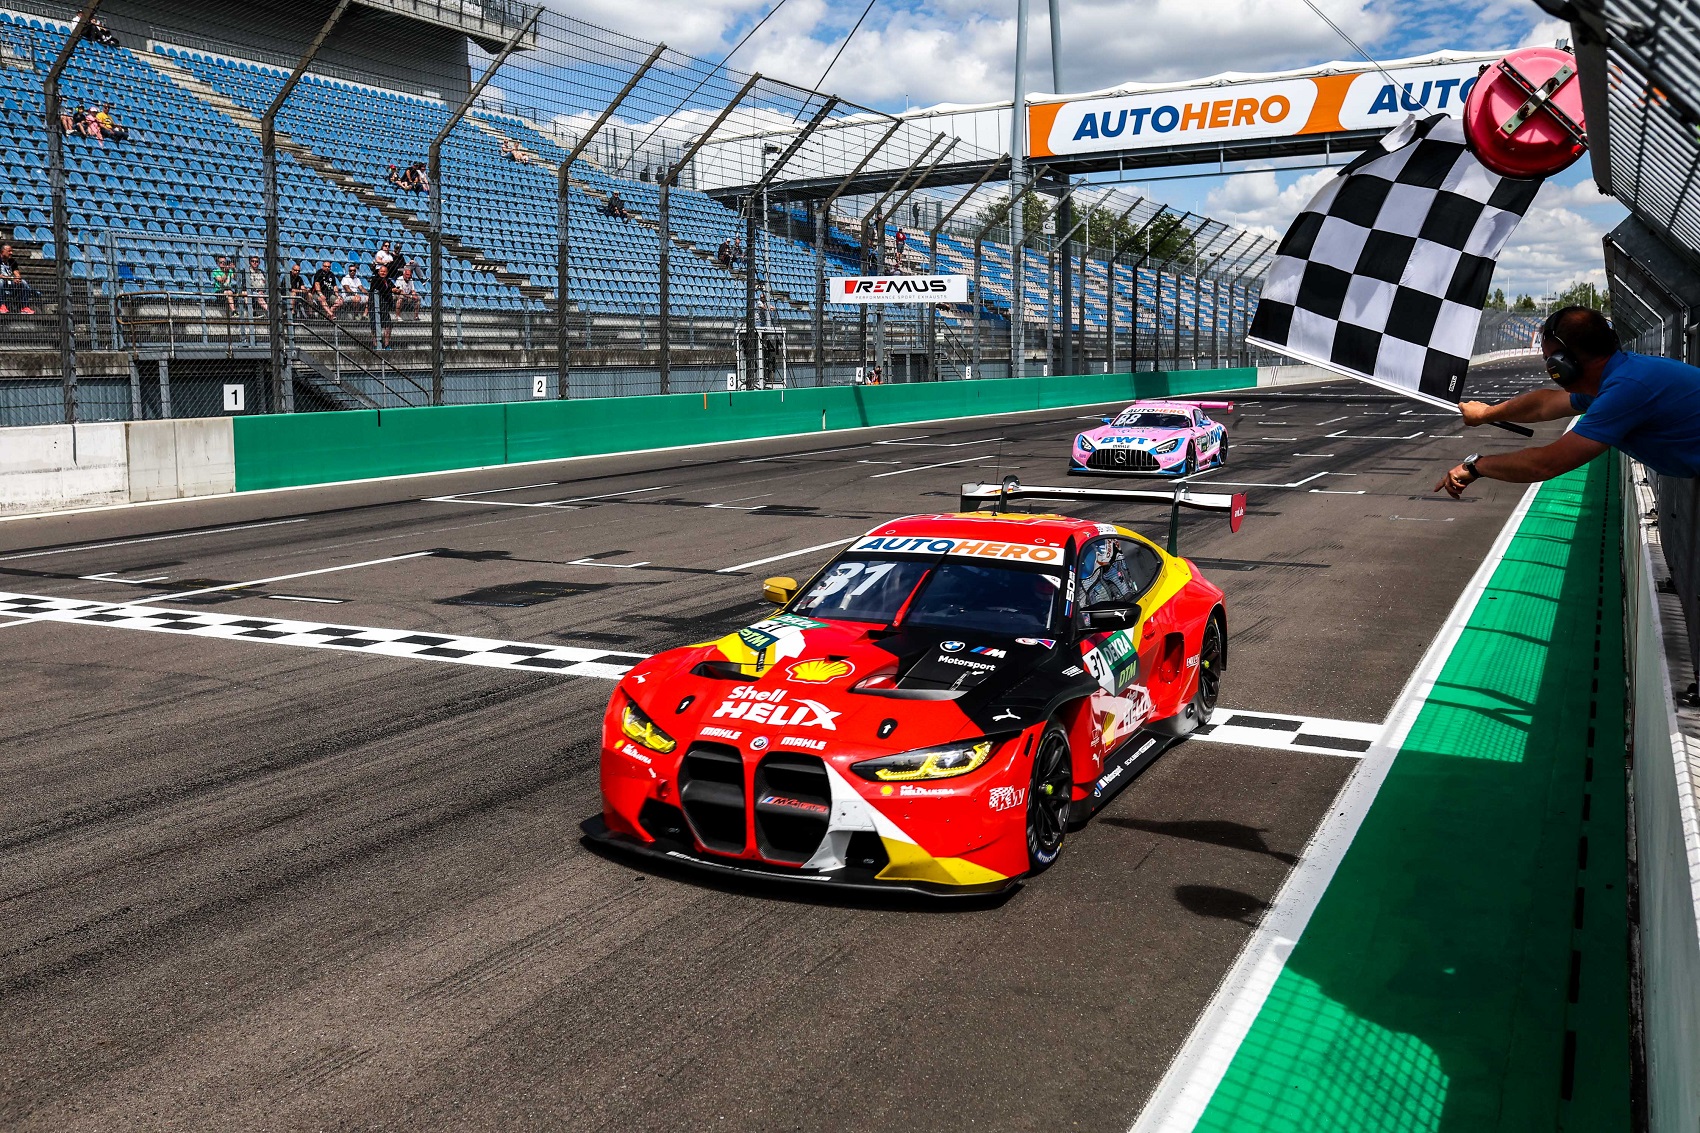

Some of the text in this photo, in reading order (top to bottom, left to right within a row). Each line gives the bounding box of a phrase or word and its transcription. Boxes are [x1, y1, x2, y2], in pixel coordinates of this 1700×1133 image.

[1072, 95, 1291, 141] AUTOHERO
[855, 280, 947, 293] REMUS
[729, 376, 735, 387] 3
[857, 369, 862, 379] 4
[536, 379, 544, 394] 2
[230, 390, 239, 406] 1
[1100, 436, 1149, 445] BWT
[857, 537, 1058, 562] AUTOHERO
[1103, 634, 1132, 666] DEKRA
[937, 655, 997, 672] Motorsport
[1090, 651, 1106, 681] 31
[1118, 659, 1137, 688] DTM
[727, 685, 788, 703] Shell
[711, 697, 843, 731] HELIX
[699, 726, 743, 740] MAHLE
[780, 736, 828, 751] MAHLE
[995, 788, 1026, 812] KW
